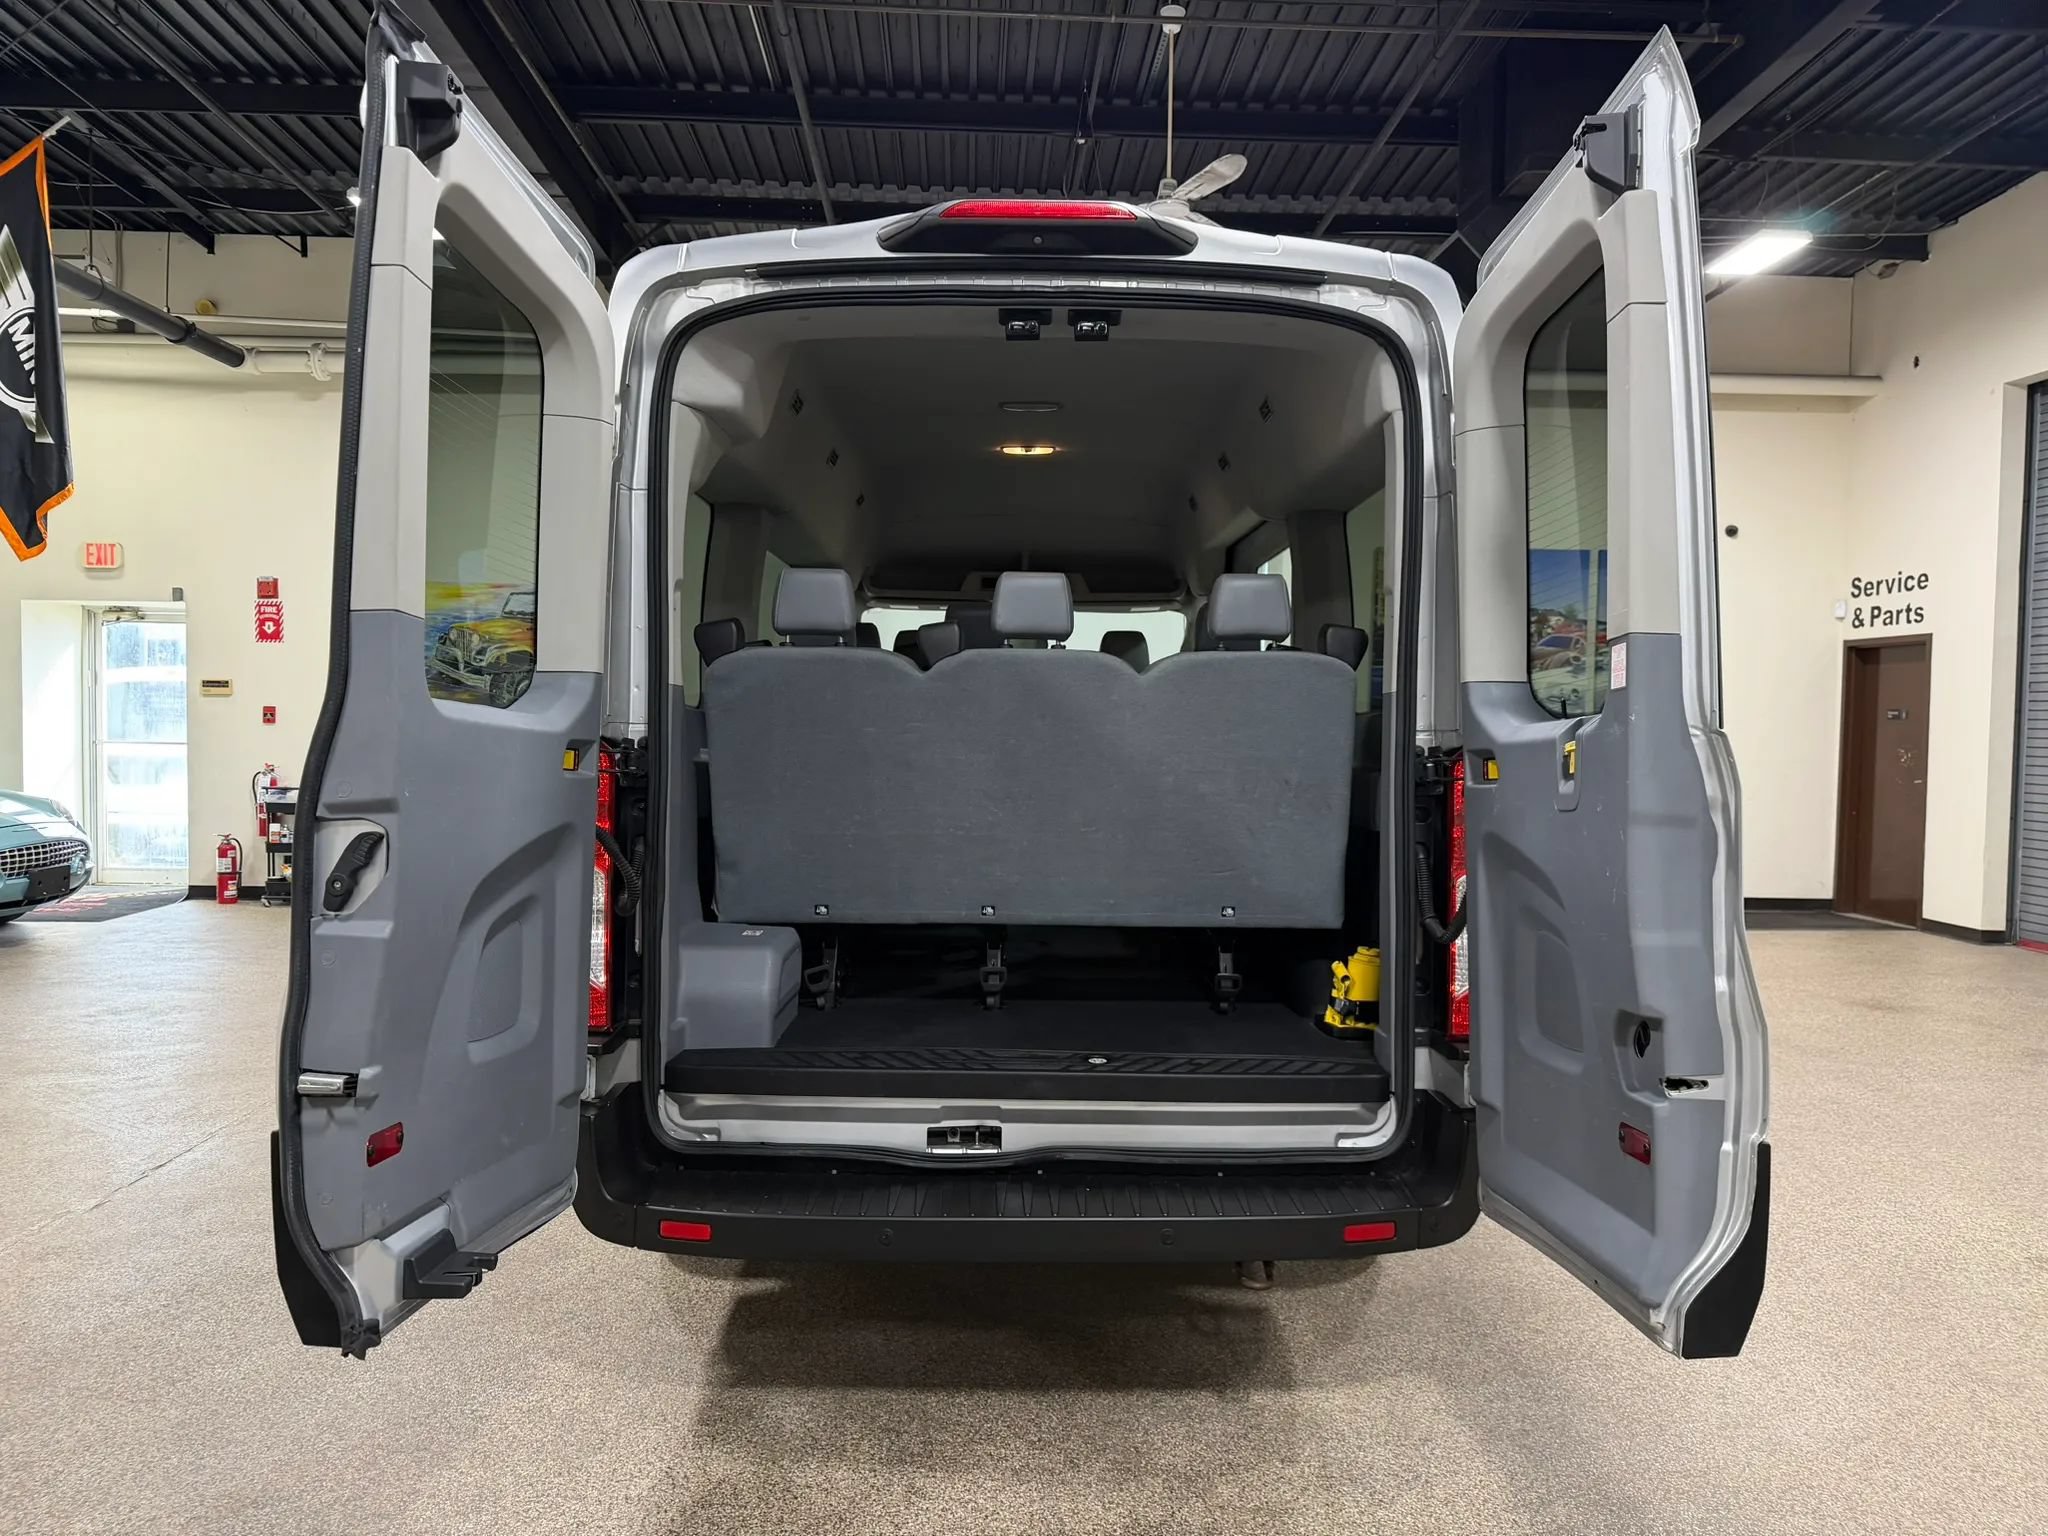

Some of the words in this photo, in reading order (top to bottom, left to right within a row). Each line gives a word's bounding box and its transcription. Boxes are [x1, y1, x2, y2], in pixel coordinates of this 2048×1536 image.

[86, 543, 116, 566] EXIT
[1850, 571, 1929, 599] Service
[260, 605, 278, 613] FIRE
[1851, 607, 1865, 629] &
[1870, 602, 1925, 627] Parts
